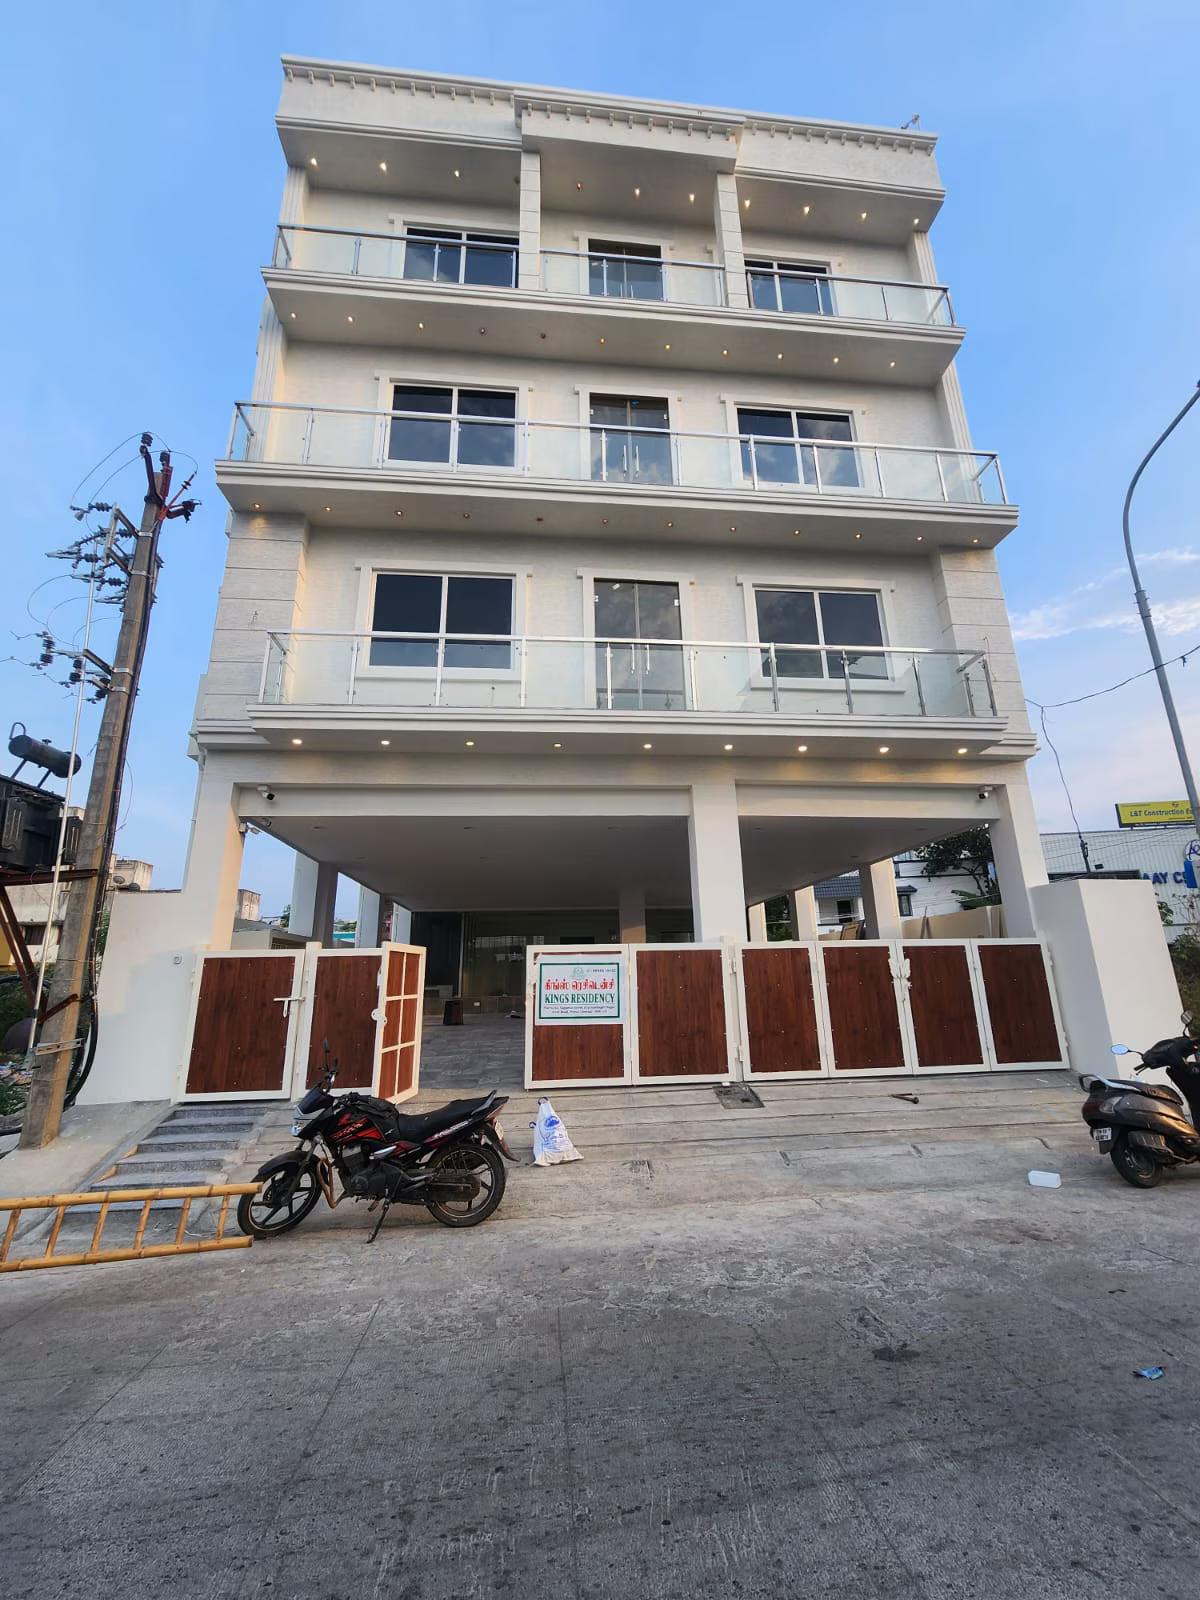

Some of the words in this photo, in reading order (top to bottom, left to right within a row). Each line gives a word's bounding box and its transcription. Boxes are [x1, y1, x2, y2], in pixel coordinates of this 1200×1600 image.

[1144, 808, 1184, 817] Construction
[544, 993, 569, 1004] KINGS
[571, 993, 615, 1004] RESIDENCY
